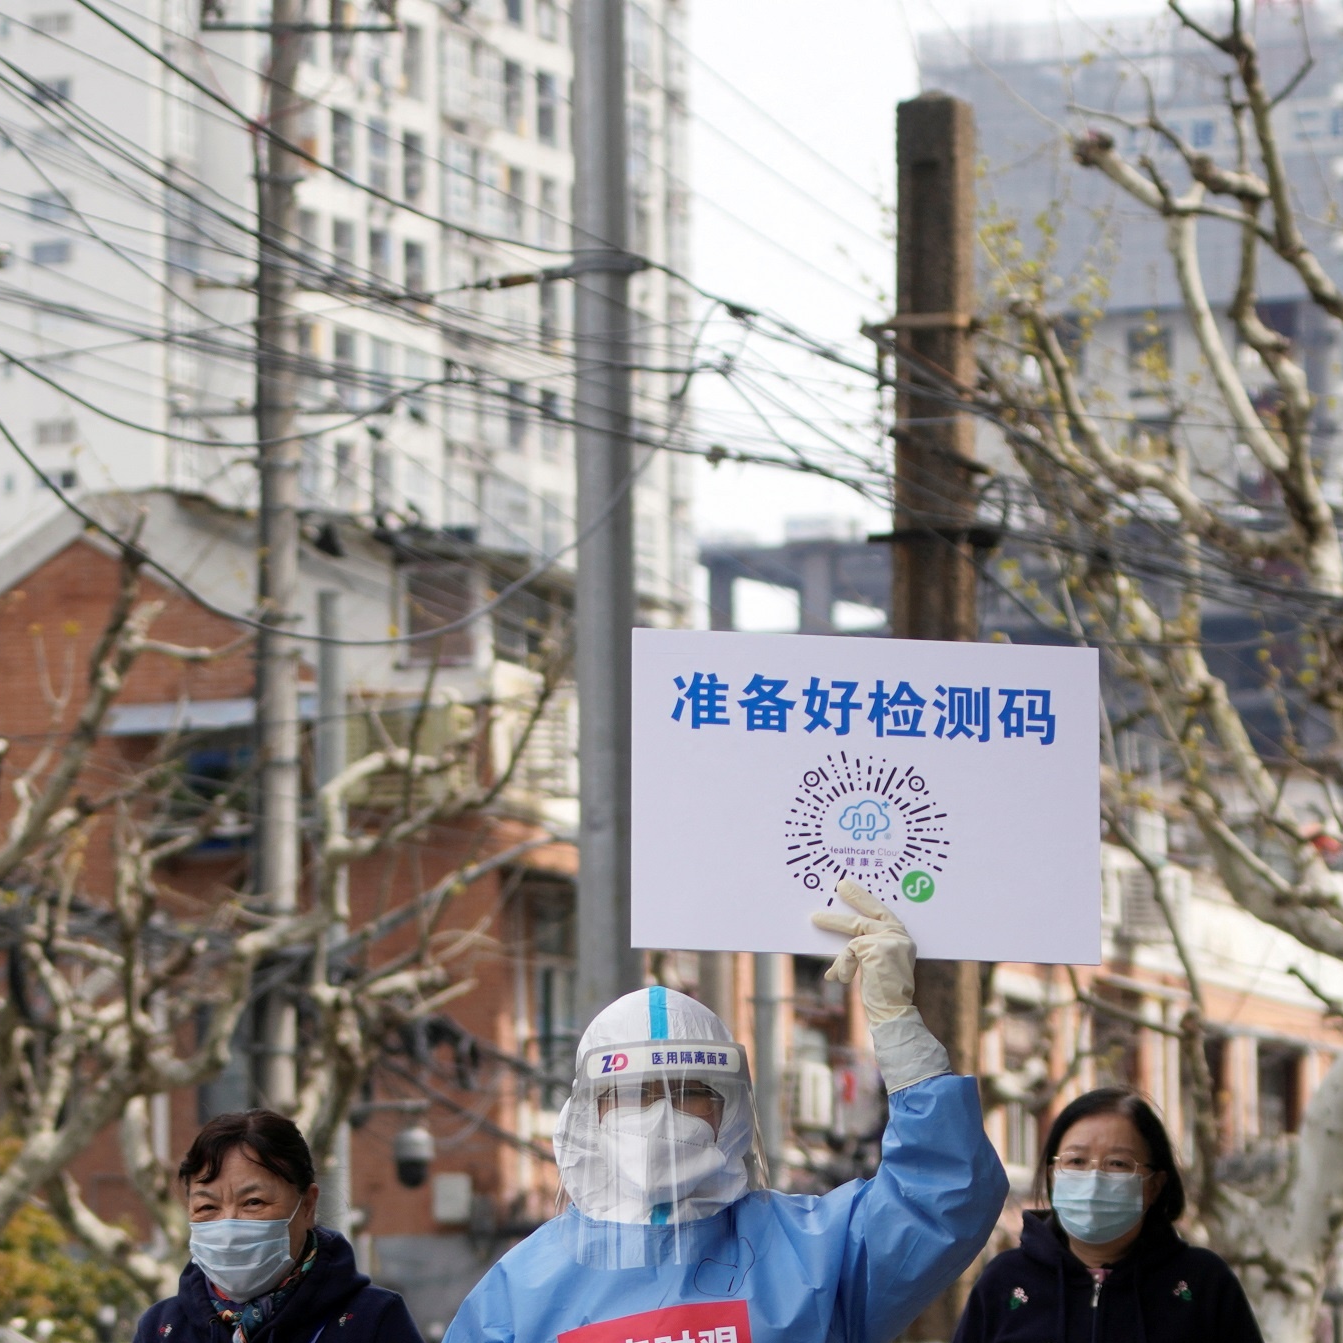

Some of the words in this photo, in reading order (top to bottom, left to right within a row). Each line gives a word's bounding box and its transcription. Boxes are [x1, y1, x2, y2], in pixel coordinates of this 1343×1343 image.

[670, 671, 1057, 745] 准备好检测码
[877, 847, 899, 856] Clou
[845, 857, 883, 867] 健康云
[651, 1050, 729, 1066] 医用隔离面罩
